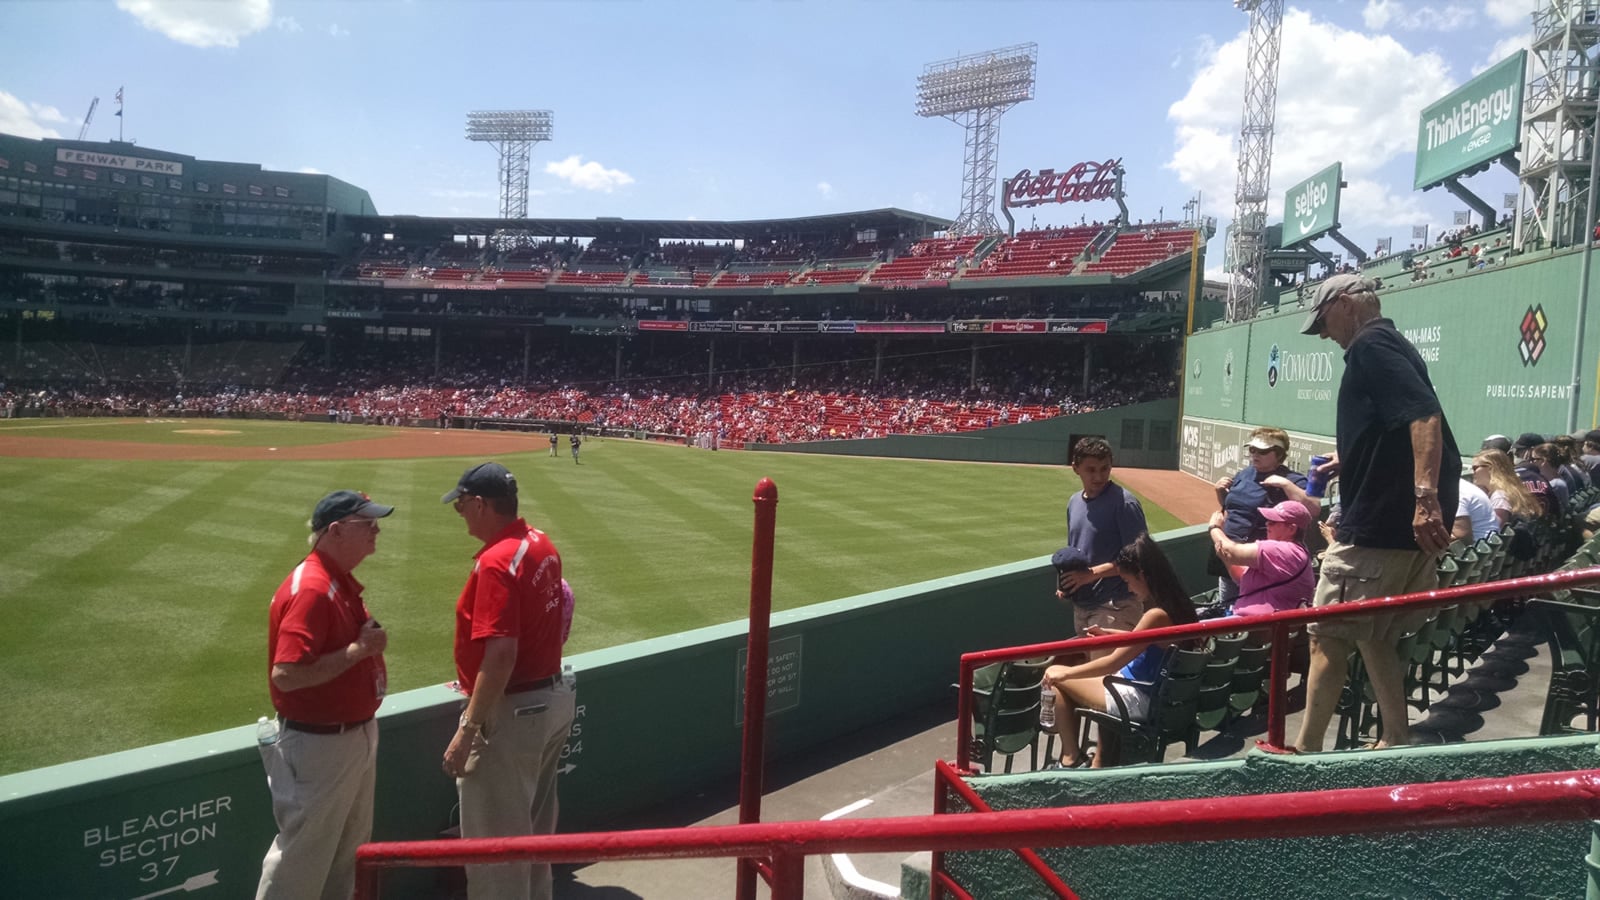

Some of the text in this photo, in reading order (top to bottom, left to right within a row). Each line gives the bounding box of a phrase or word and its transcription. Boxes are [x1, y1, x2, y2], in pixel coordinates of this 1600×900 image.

[1426, 85, 1514, 151] ThinkEnergy
[65, 151, 175, 172] FENWAY PARK
[1005, 157, 1122, 208] Coca-Cola
[1281, 350, 1333, 382] FOXWOODS
[1486, 384, 1571, 399] PUBLICIS.SAPIENT
[84, 796, 232, 847] BLEACHER
[99, 822, 217, 867] SECTION
[139, 855, 181, 882] 37
